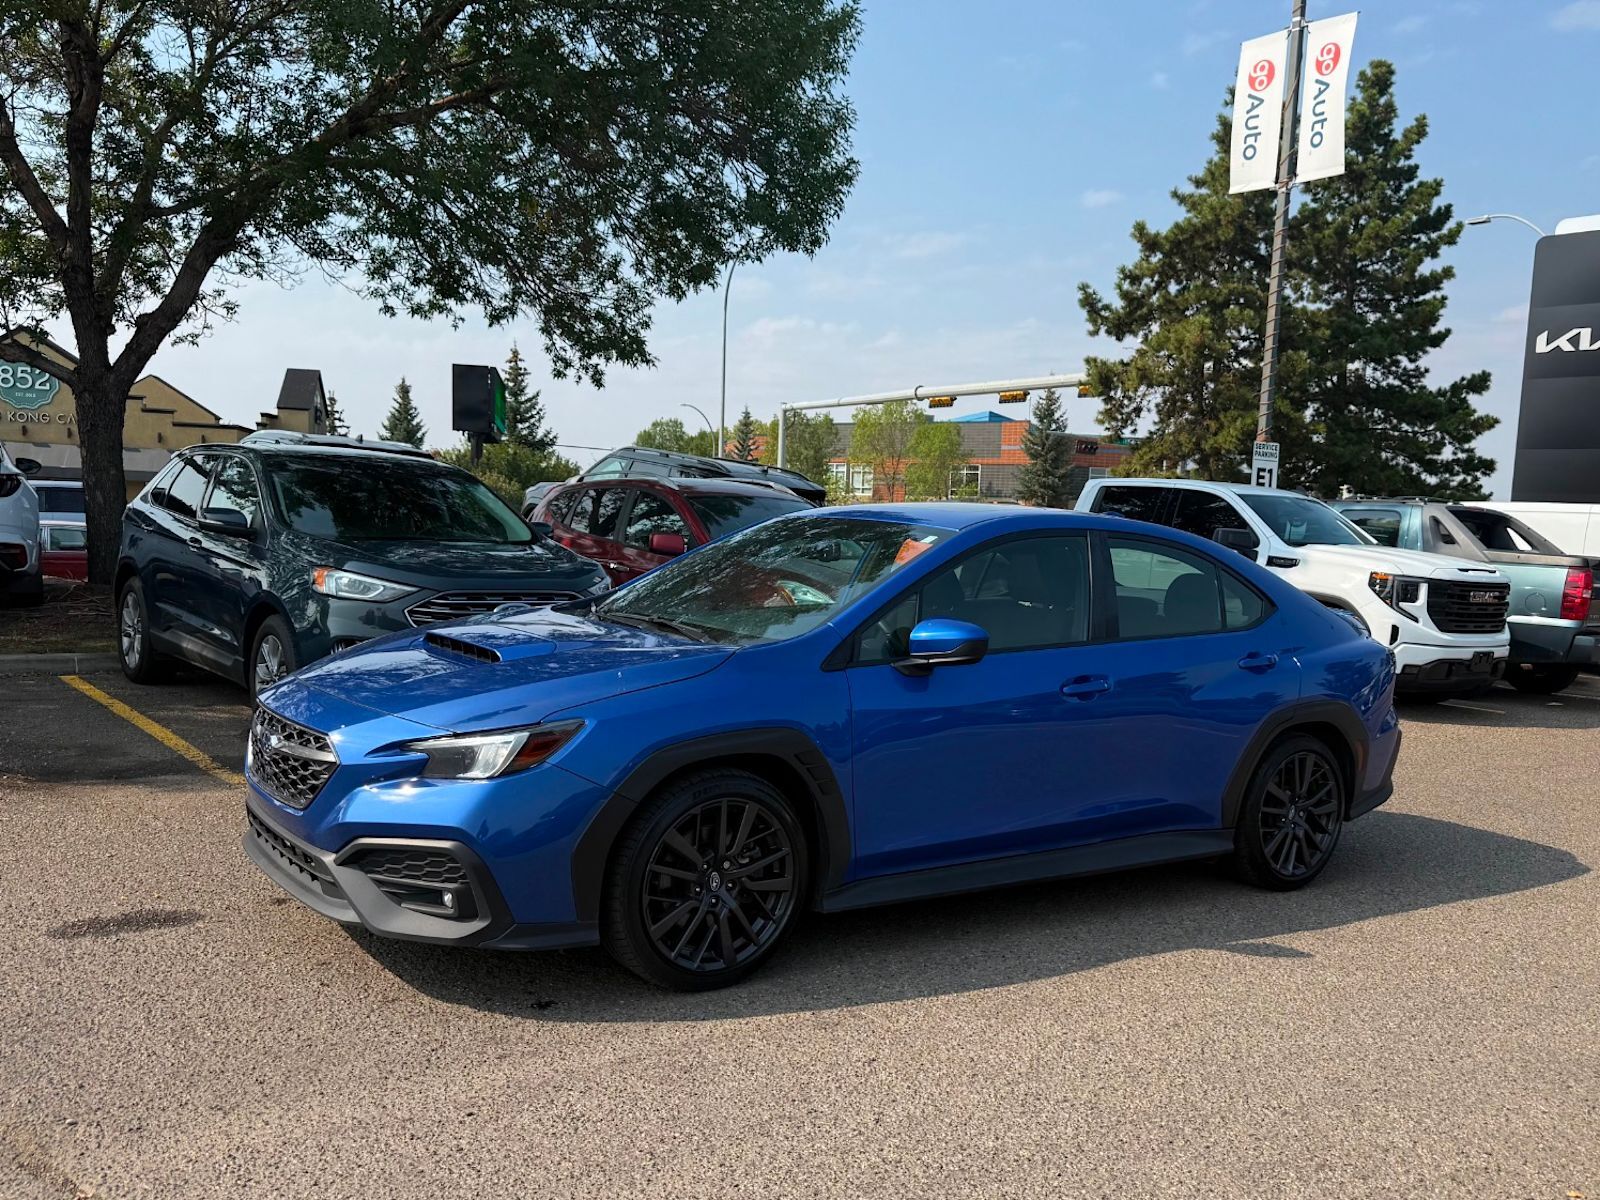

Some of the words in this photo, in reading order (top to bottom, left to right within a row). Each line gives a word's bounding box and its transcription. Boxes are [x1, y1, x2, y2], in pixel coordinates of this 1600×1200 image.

[1310, 78, 1330, 149] Auto
[1242, 93, 1265, 161] Auto
[0, 365, 51, 390] 852
[7, 410, 50, 424] KONG
[1254, 450, 1278, 459] PARKING
[1255, 443, 1279, 451] SERVICE
[1256, 467, 1274, 488] E1
